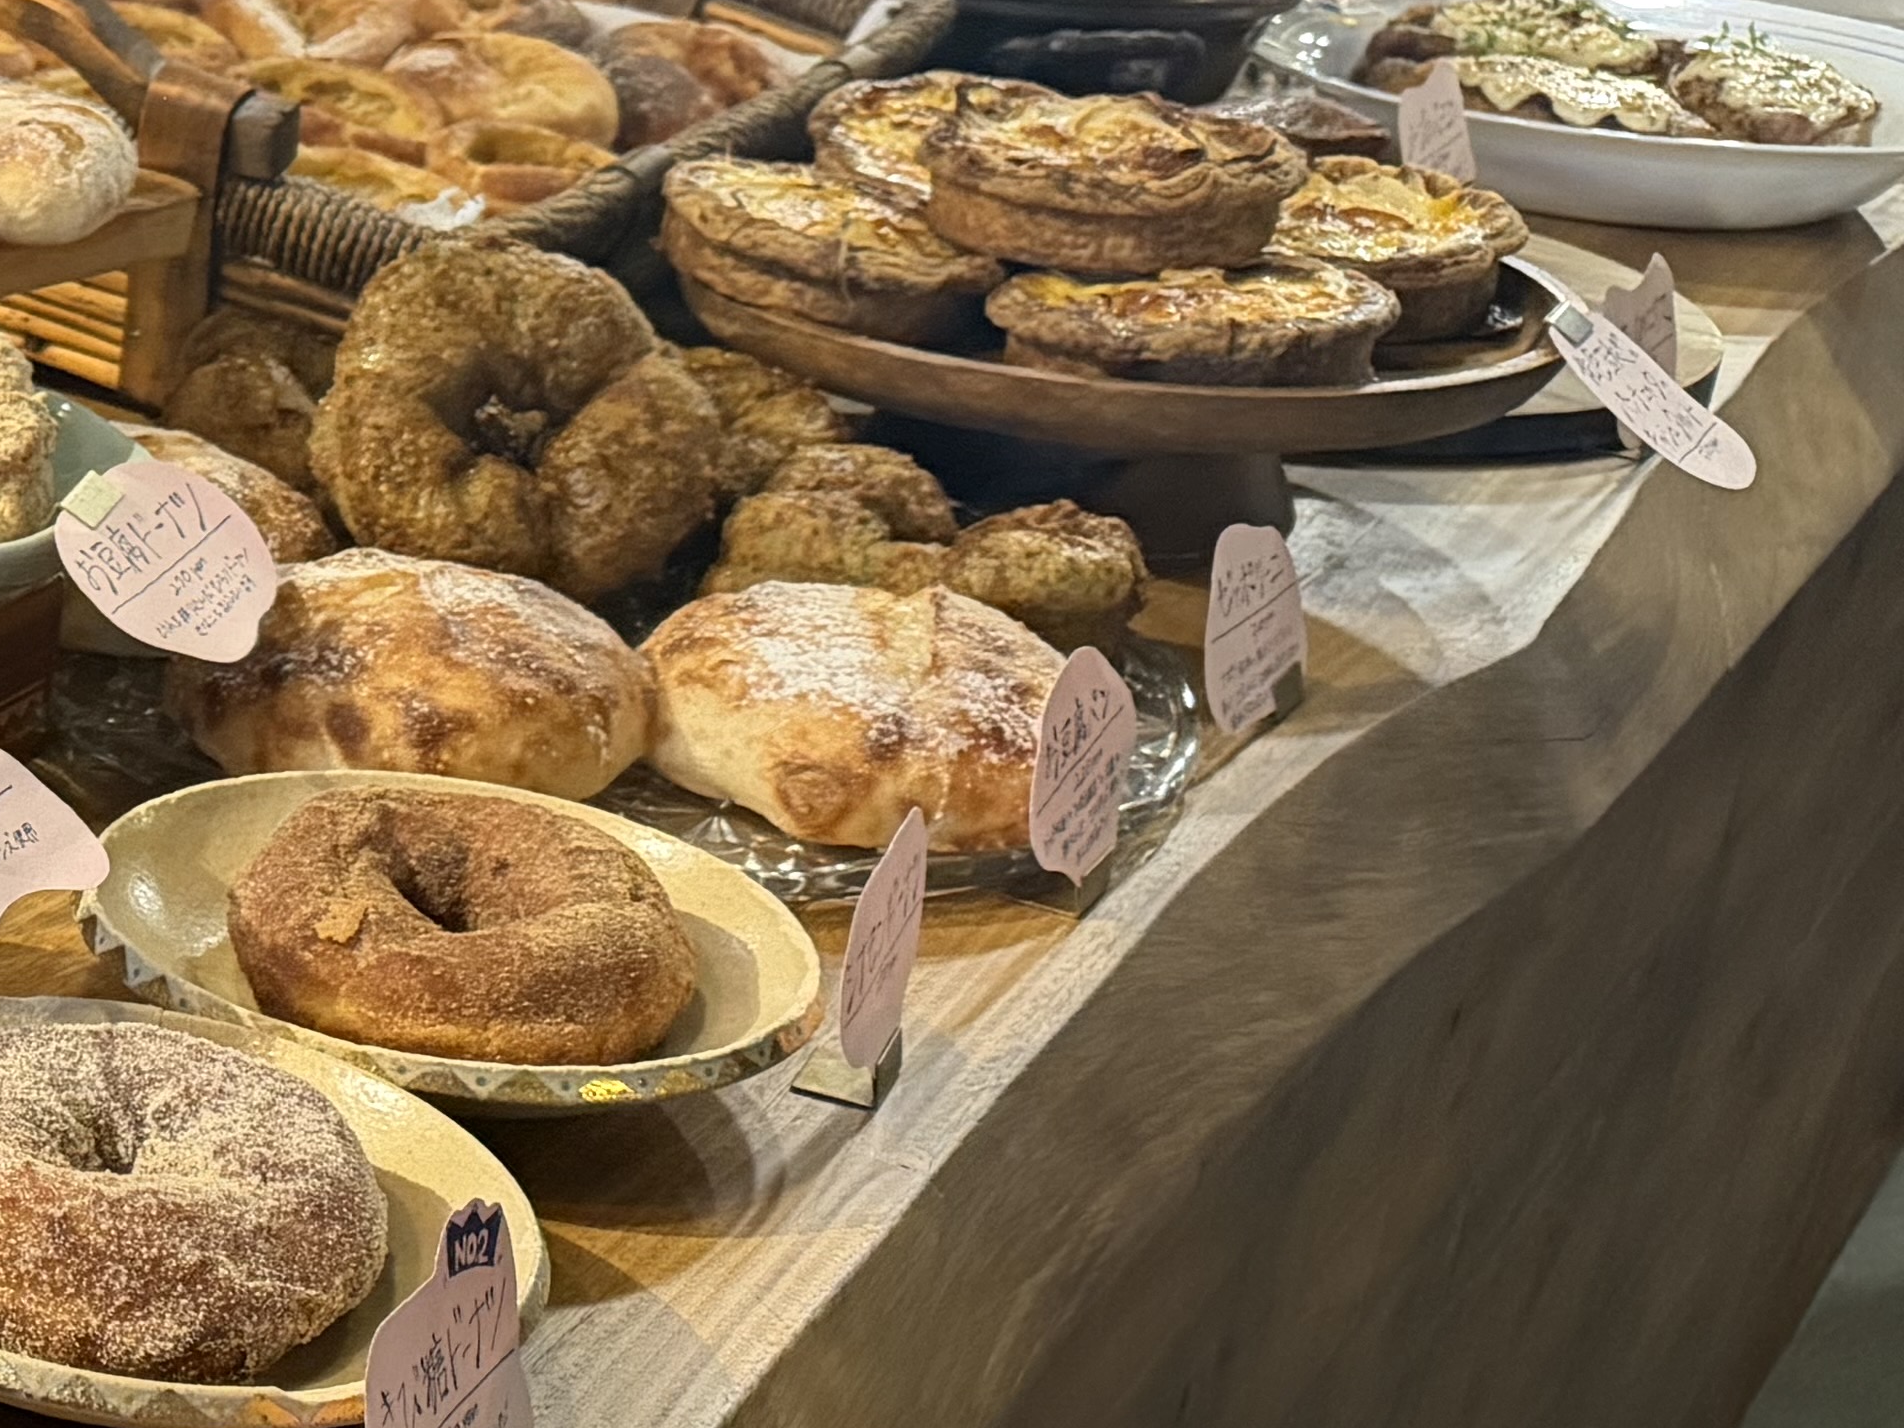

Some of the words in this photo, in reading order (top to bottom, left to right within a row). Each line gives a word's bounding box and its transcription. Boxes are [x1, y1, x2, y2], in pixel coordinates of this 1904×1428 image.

[74, 481, 207, 595] お豆腐ドーナツ
